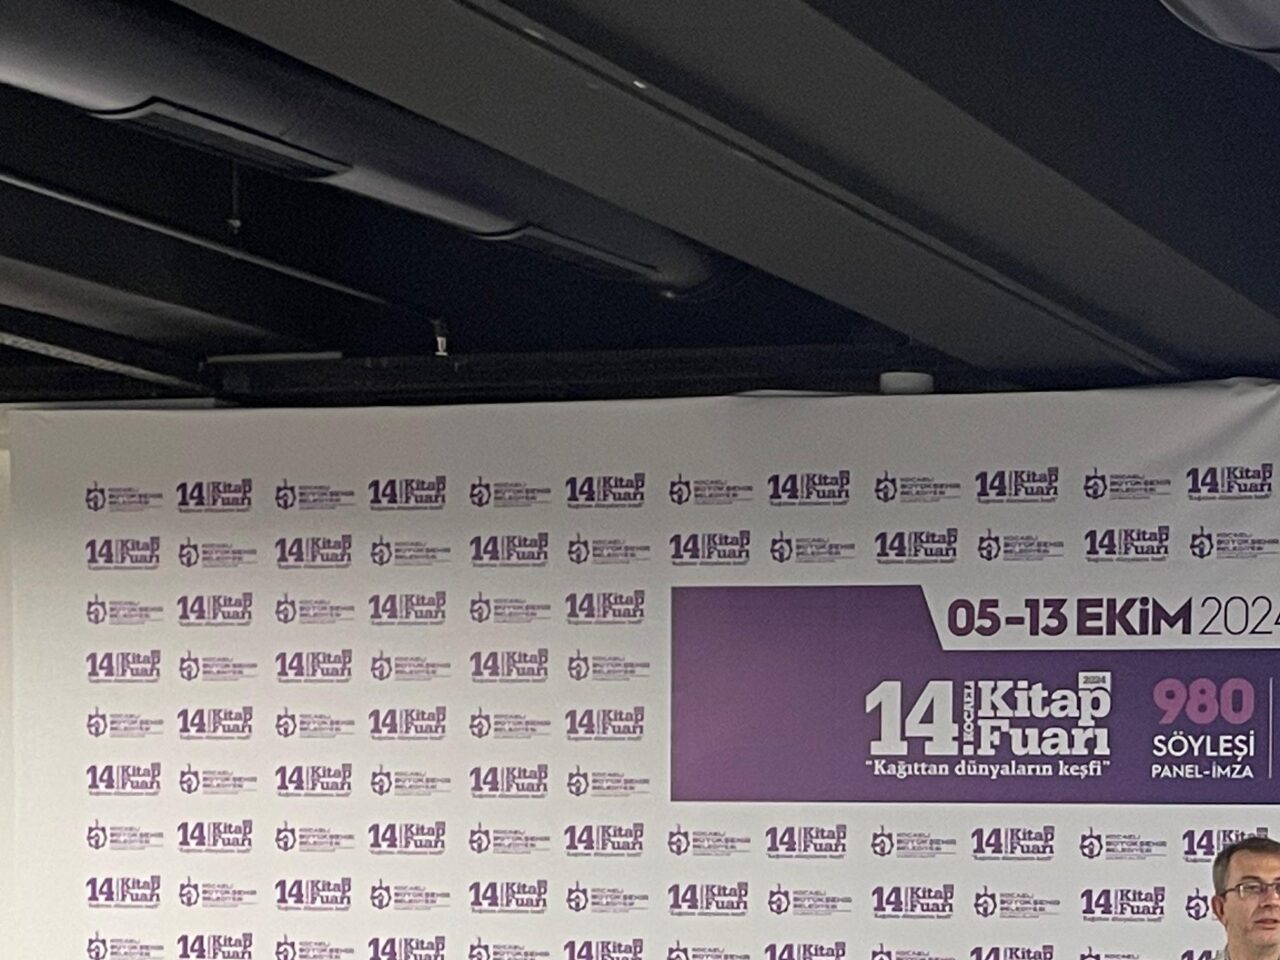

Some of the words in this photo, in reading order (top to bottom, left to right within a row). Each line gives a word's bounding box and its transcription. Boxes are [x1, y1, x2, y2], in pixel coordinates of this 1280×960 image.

[768, 474, 799, 499] 14
[805, 472, 850, 489] Kitap
[176, 482, 205, 506] 14
[1085, 529, 1116, 554] 14
[1123, 527, 1170, 544] Kitap
[470, 536, 499, 560] 14
[947, 598, 1068, 636] 05-13
[87, 653, 114, 676] 14
[1082, 675, 1107, 685] 2024
[977, 680, 1111, 727] Kitap
[1153, 677, 1255, 725] 980
[178, 709, 206, 732] 14
[865, 680, 958, 756] 14
[976, 718, 1111, 756] Fuarı
[1152, 730, 1255, 762] SÖYLEŞİ
[276, 766, 304, 789] 14
[954, 759, 1053, 779] dünyaların
[1151, 762, 1254, 778] PANEL-İMZA
[369, 824, 397, 847] 14
[86, 878, 114, 901] 14
[668, 884, 698, 908] 14
[872, 887, 903, 912] 14
[909, 887, 954, 903] Kitap
